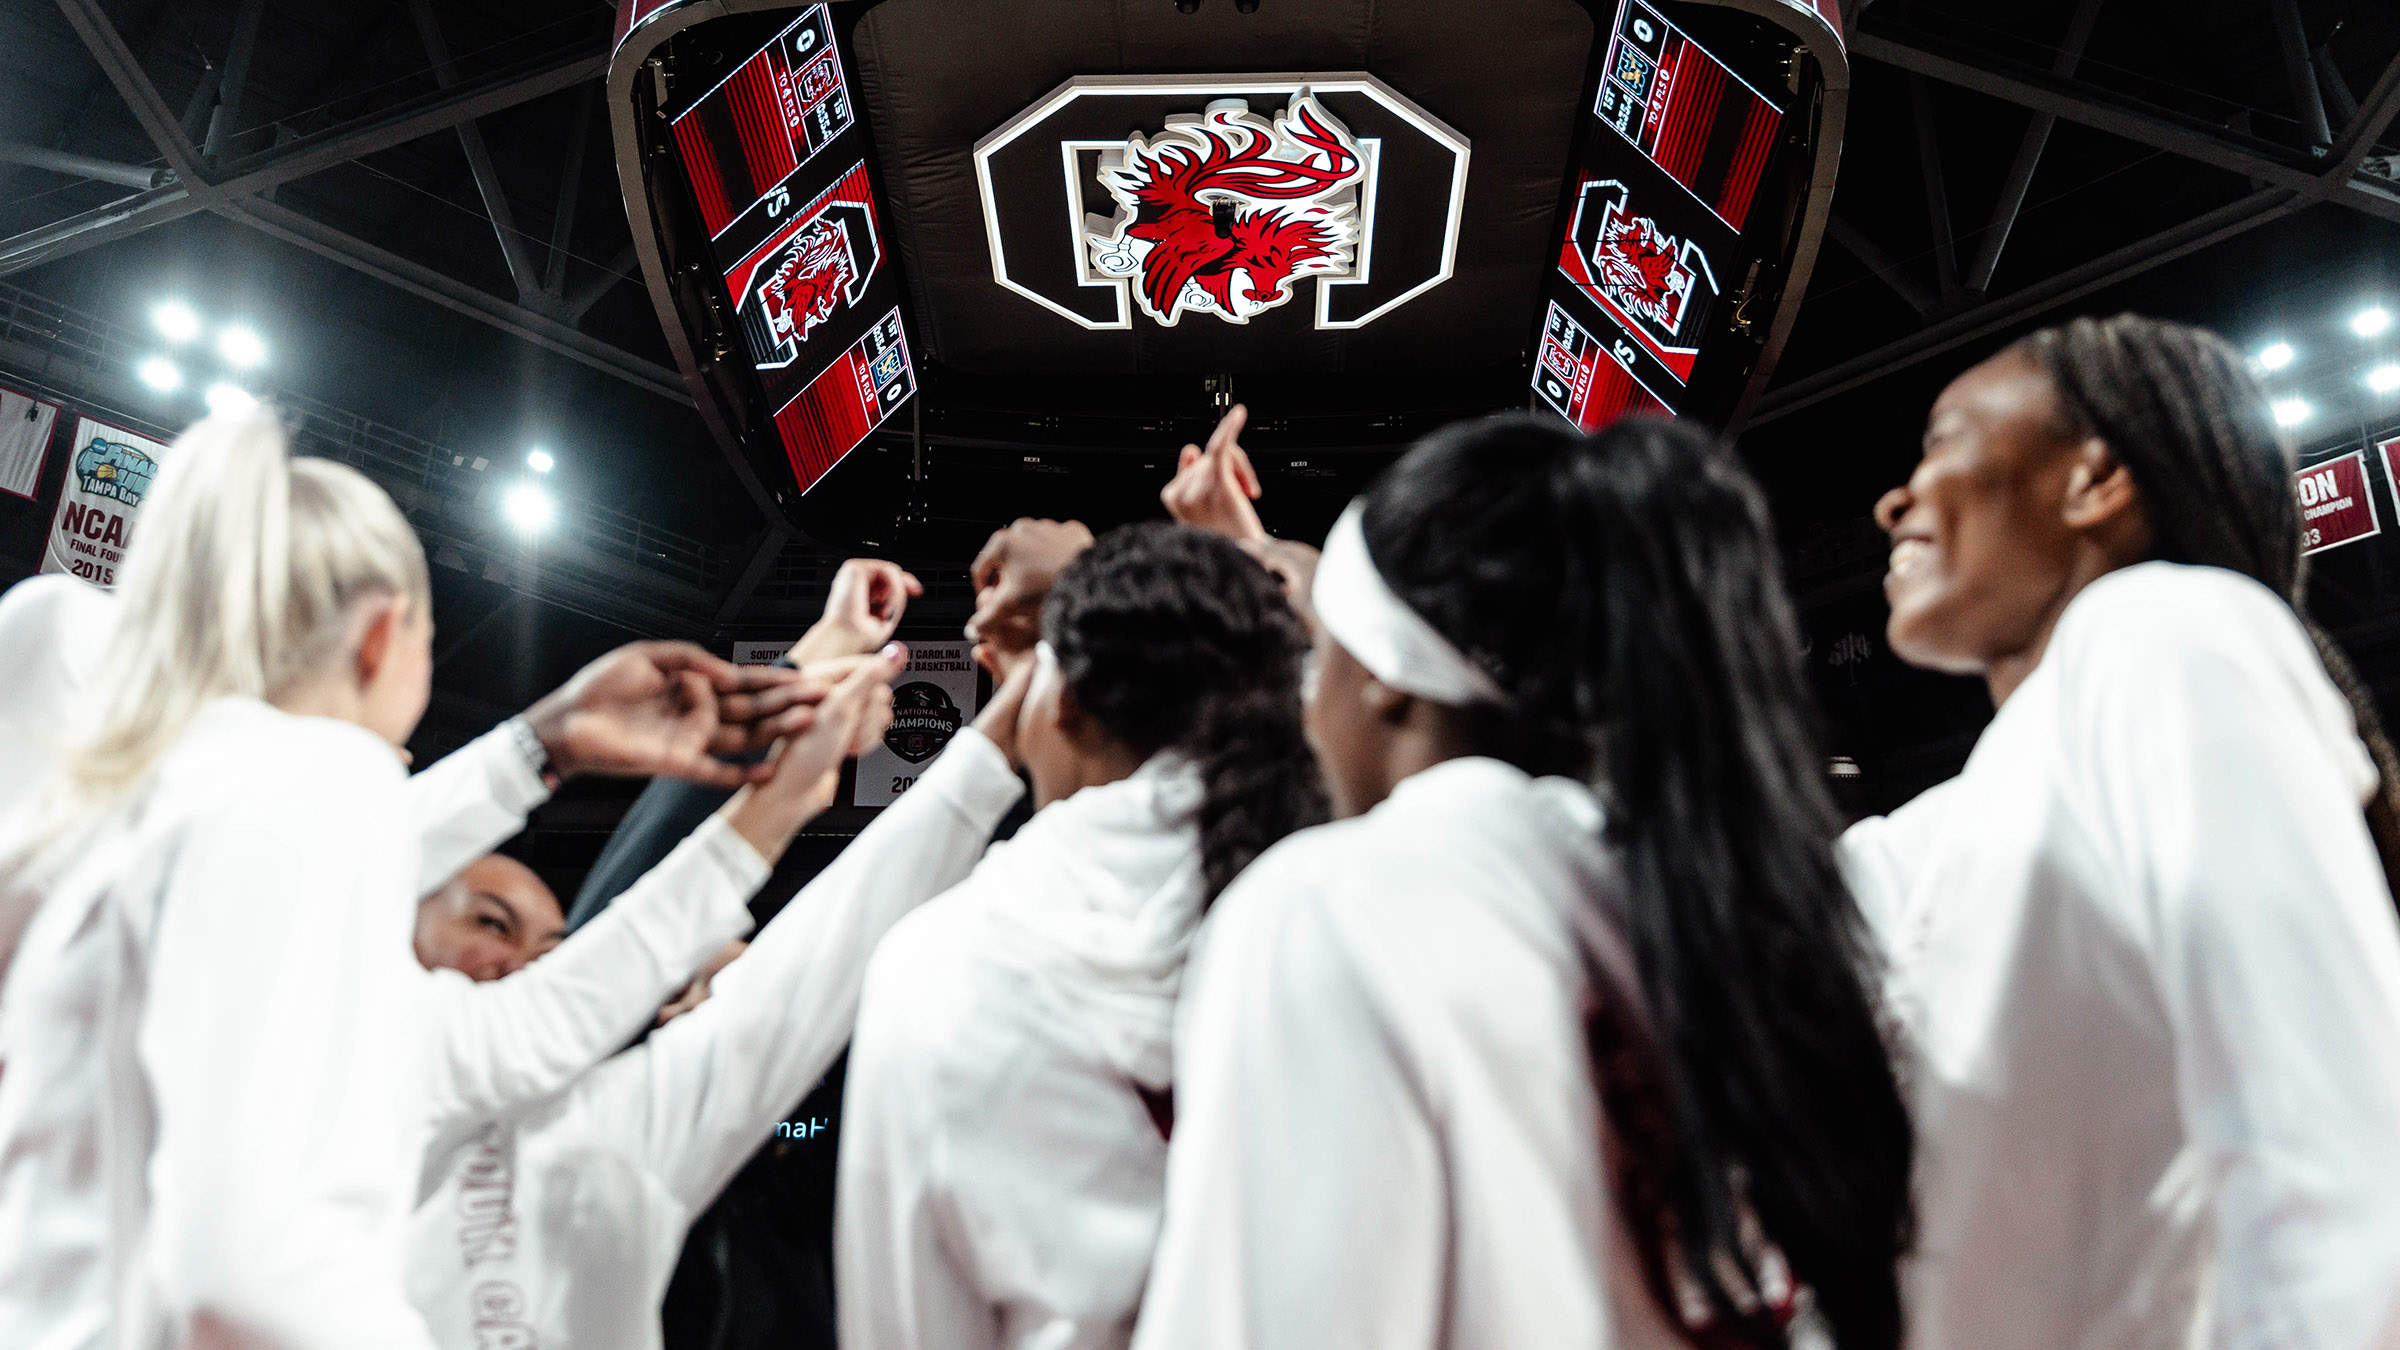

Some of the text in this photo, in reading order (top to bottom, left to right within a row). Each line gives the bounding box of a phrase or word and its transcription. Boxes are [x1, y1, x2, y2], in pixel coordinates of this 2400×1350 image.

[833, 96, 847, 120] 1ST
[1602, 86, 1616, 111] 1ST
[887, 319, 898, 338] 1ST
[1551, 312, 1562, 332] 1ST
[82, 475, 140, 507] TAMPA BAY
[2303, 496, 2353, 521] CHAMPION
[70, 538, 97, 557] FINAL
[71, 558, 114, 585] 2015
[750, 650, 780, 660] SOUTH
[916, 649, 961, 660] CAROLINA
[914, 661, 972, 672] BASKETBALL
[896, 708, 939, 717] NATIONAL
